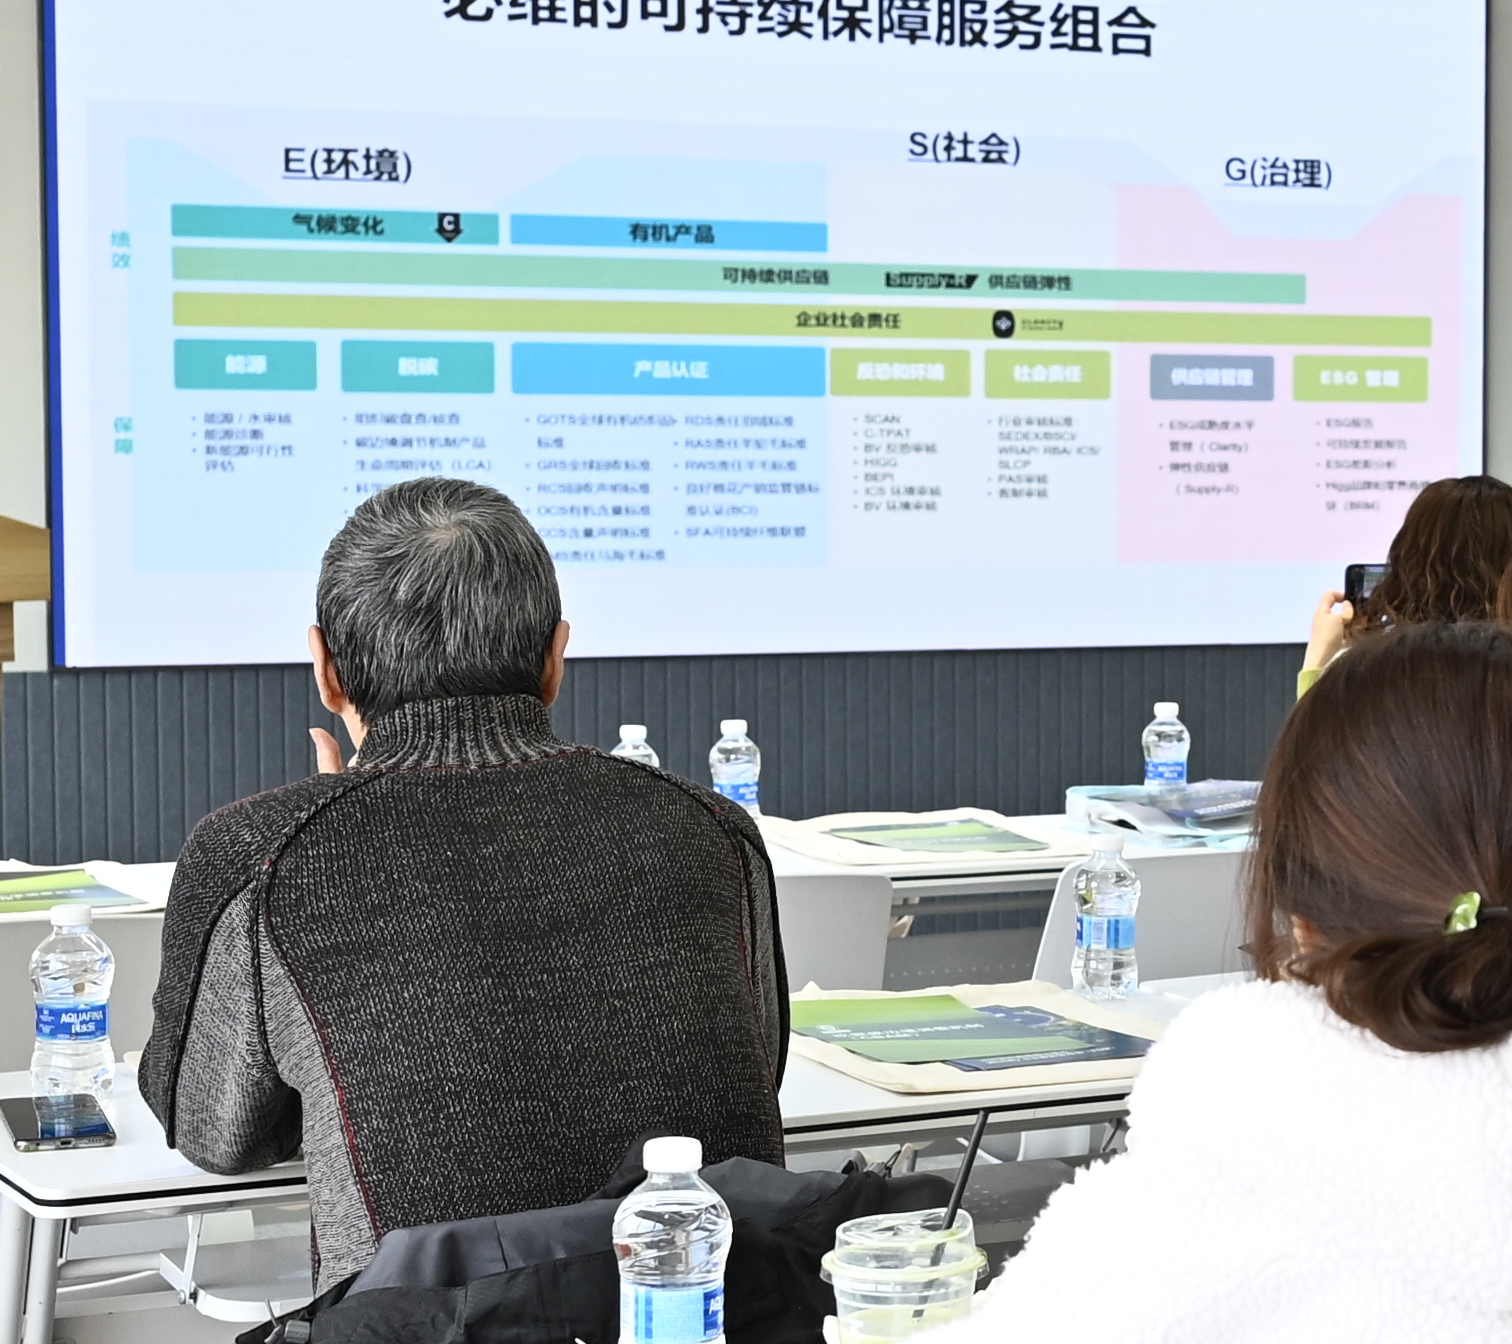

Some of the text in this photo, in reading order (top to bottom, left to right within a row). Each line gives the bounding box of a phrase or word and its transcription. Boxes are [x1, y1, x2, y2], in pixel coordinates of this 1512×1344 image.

[908, 130, 1022, 166] S(社会)
[283, 146, 413, 183] E(环境)
[1224, 156, 1334, 190] G(治理)
[292, 212, 385, 236] 气候变化
[629, 222, 714, 245] 有机产品
[723, 267, 830, 286] 可持续供应链
[988, 273, 1072, 291] 供应链弹性
[795, 311, 901, 331] 企业社会责任
[225, 354, 267, 375] 能源
[633, 360, 709, 380] 产品认证
[1013, 364, 1082, 383] 社会责任
[1320, 370, 1358, 385] ESG
